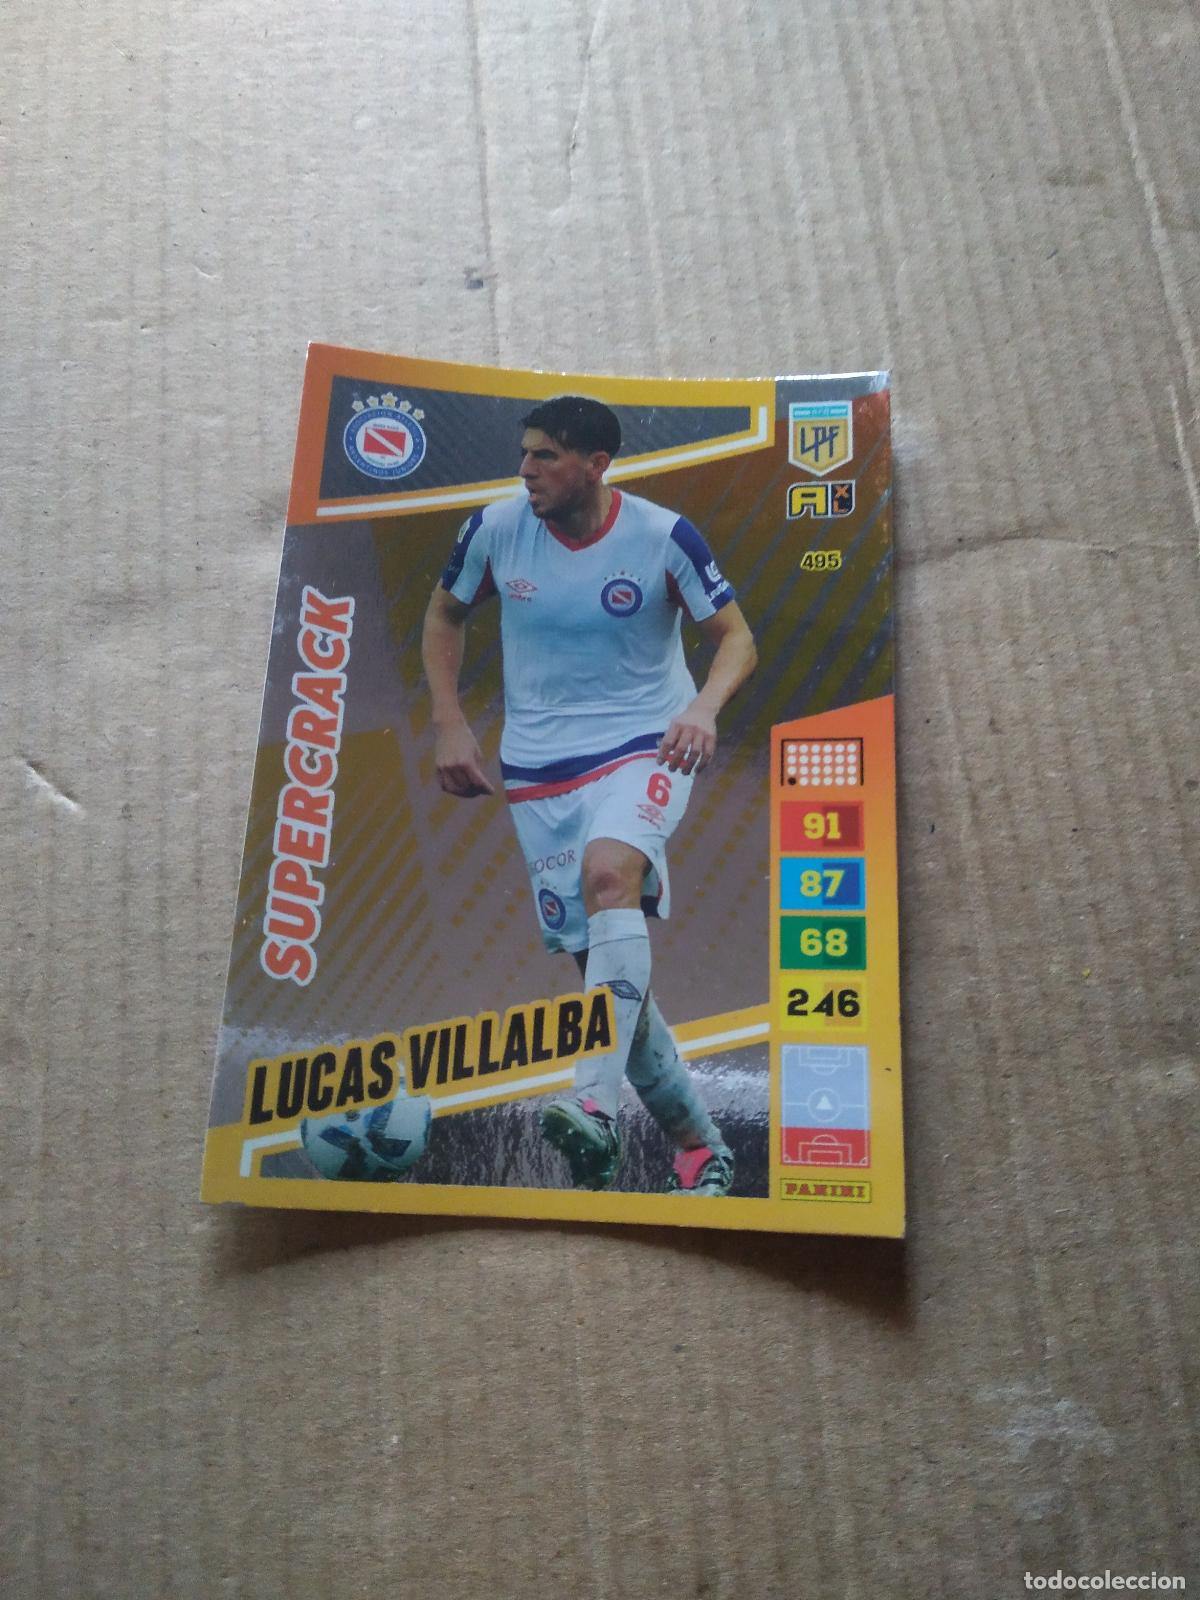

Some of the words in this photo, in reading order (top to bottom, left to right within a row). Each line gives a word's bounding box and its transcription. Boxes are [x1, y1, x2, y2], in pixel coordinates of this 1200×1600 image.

[803, 553, 840, 569] 495
[262, 588, 353, 984] SUPERCRACK
[647, 772, 672, 808] 6
[803, 812, 842, 840] 91
[800, 869, 845, 897] 87
[800, 928, 848, 957] 68
[787, 988, 861, 1017] 246
[249, 1040, 396, 1125] LUCAS
[409, 993, 611, 1090] VILLALBA
[785, 1182, 865, 1198] PANINI
